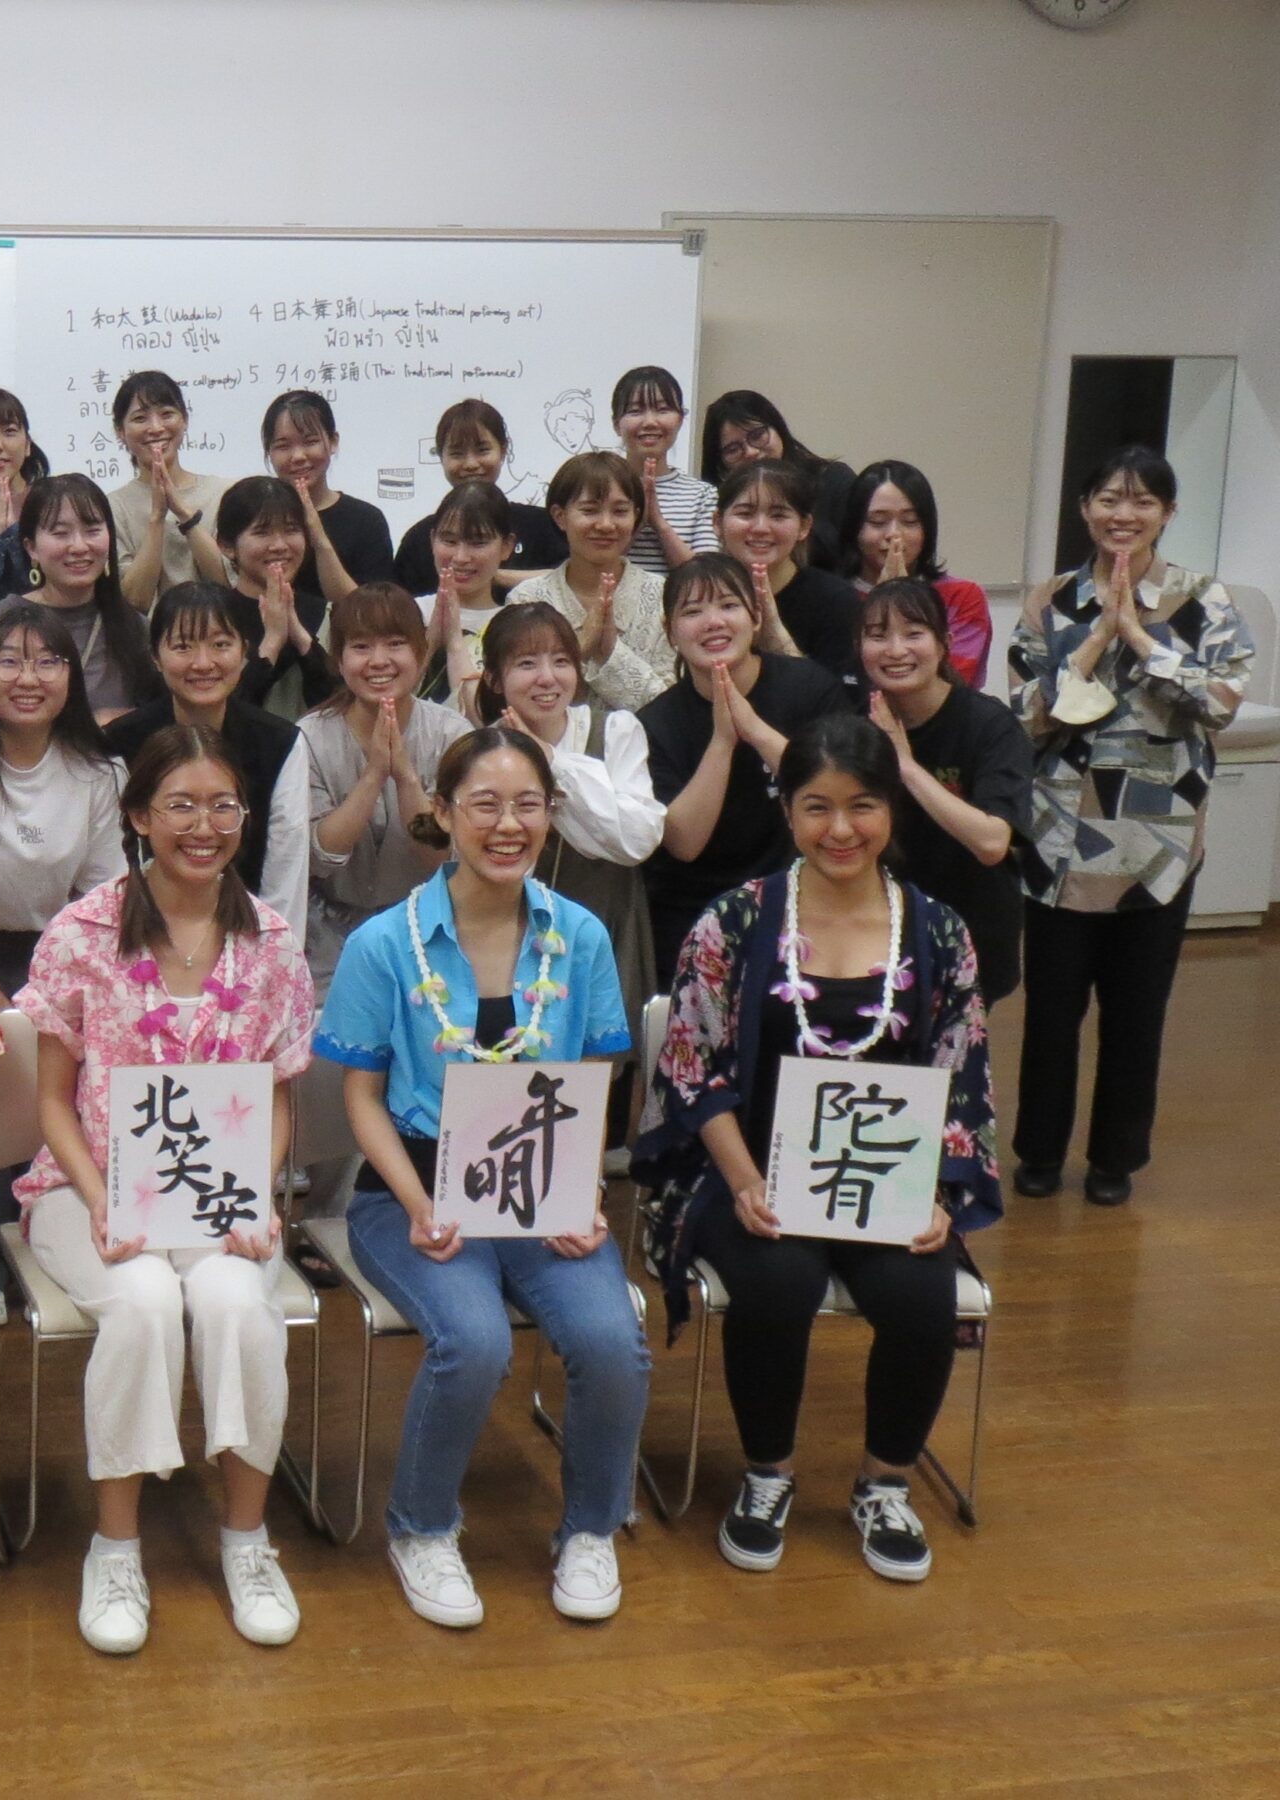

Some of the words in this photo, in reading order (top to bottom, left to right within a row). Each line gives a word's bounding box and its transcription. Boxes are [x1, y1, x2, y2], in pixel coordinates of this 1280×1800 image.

[66, 309, 76, 332] 1
[249, 303, 262, 323] 4
[67, 377, 77, 391] 2
[249, 364, 259, 384] 5
[67, 434, 76, 452] 3
